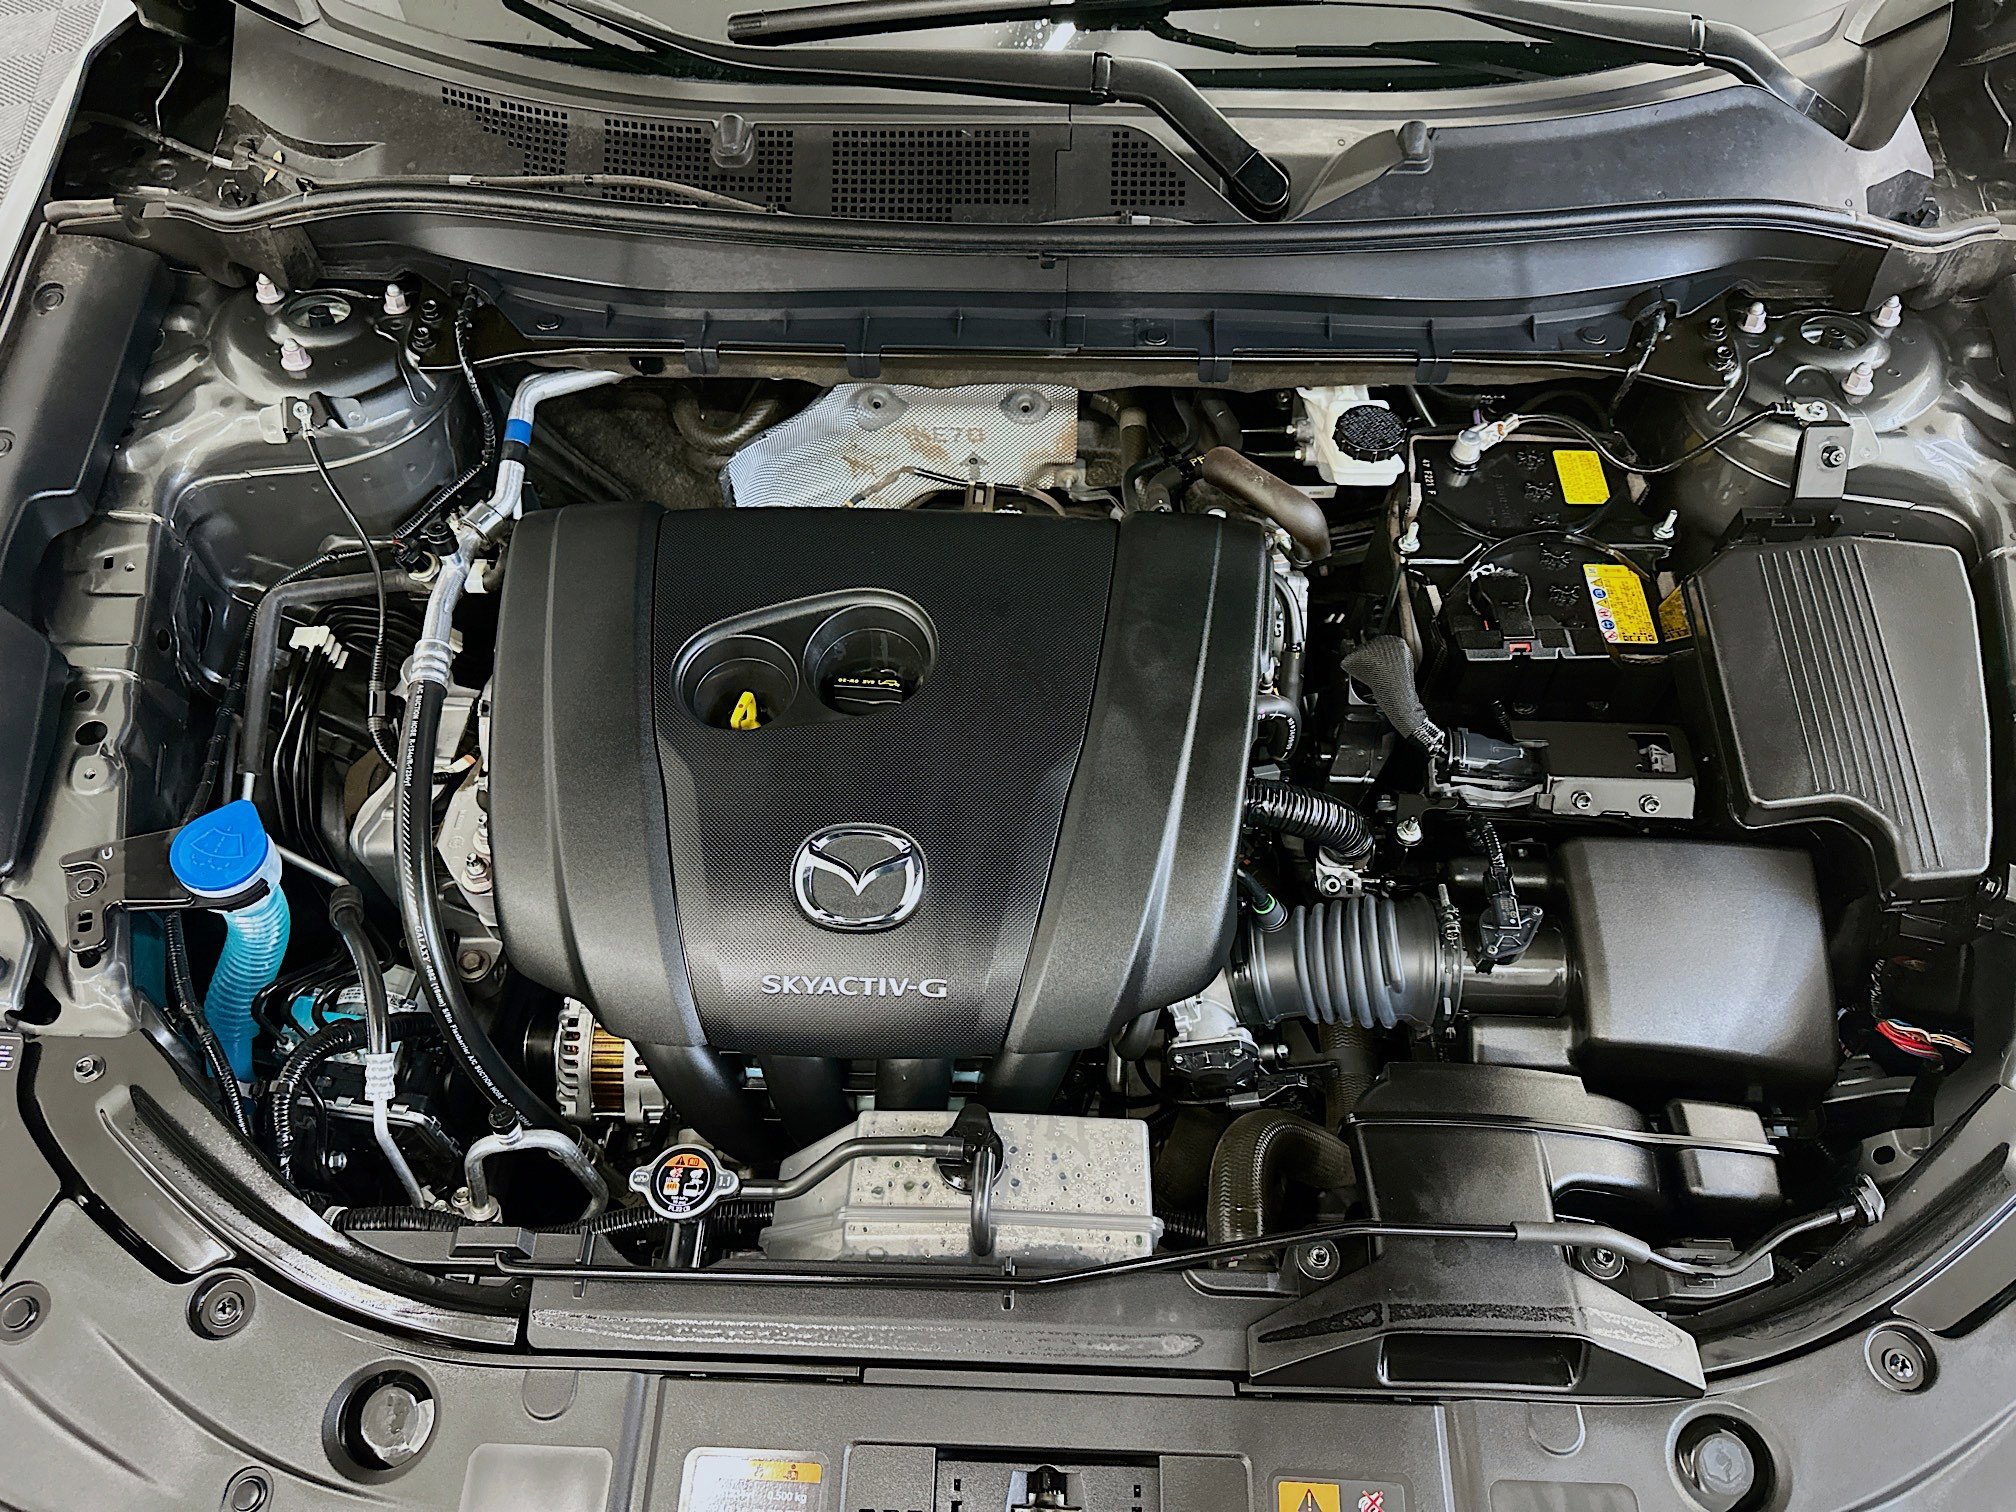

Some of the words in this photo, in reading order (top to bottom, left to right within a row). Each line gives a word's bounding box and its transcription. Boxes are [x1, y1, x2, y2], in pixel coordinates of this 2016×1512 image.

[413, 695, 422, 720] SUCTION
[410, 720, 418, 737] HOSE
[761, 974, 948, 998] SKYACTIV-G
[415, 925, 431, 964] GALAXY
[474, 1064, 494, 1087] SUCTION
[490, 1085, 504, 1100] HOSE
[718, 1176, 731, 1187] 1.1
[795, 1492, 808, 1504] kg
